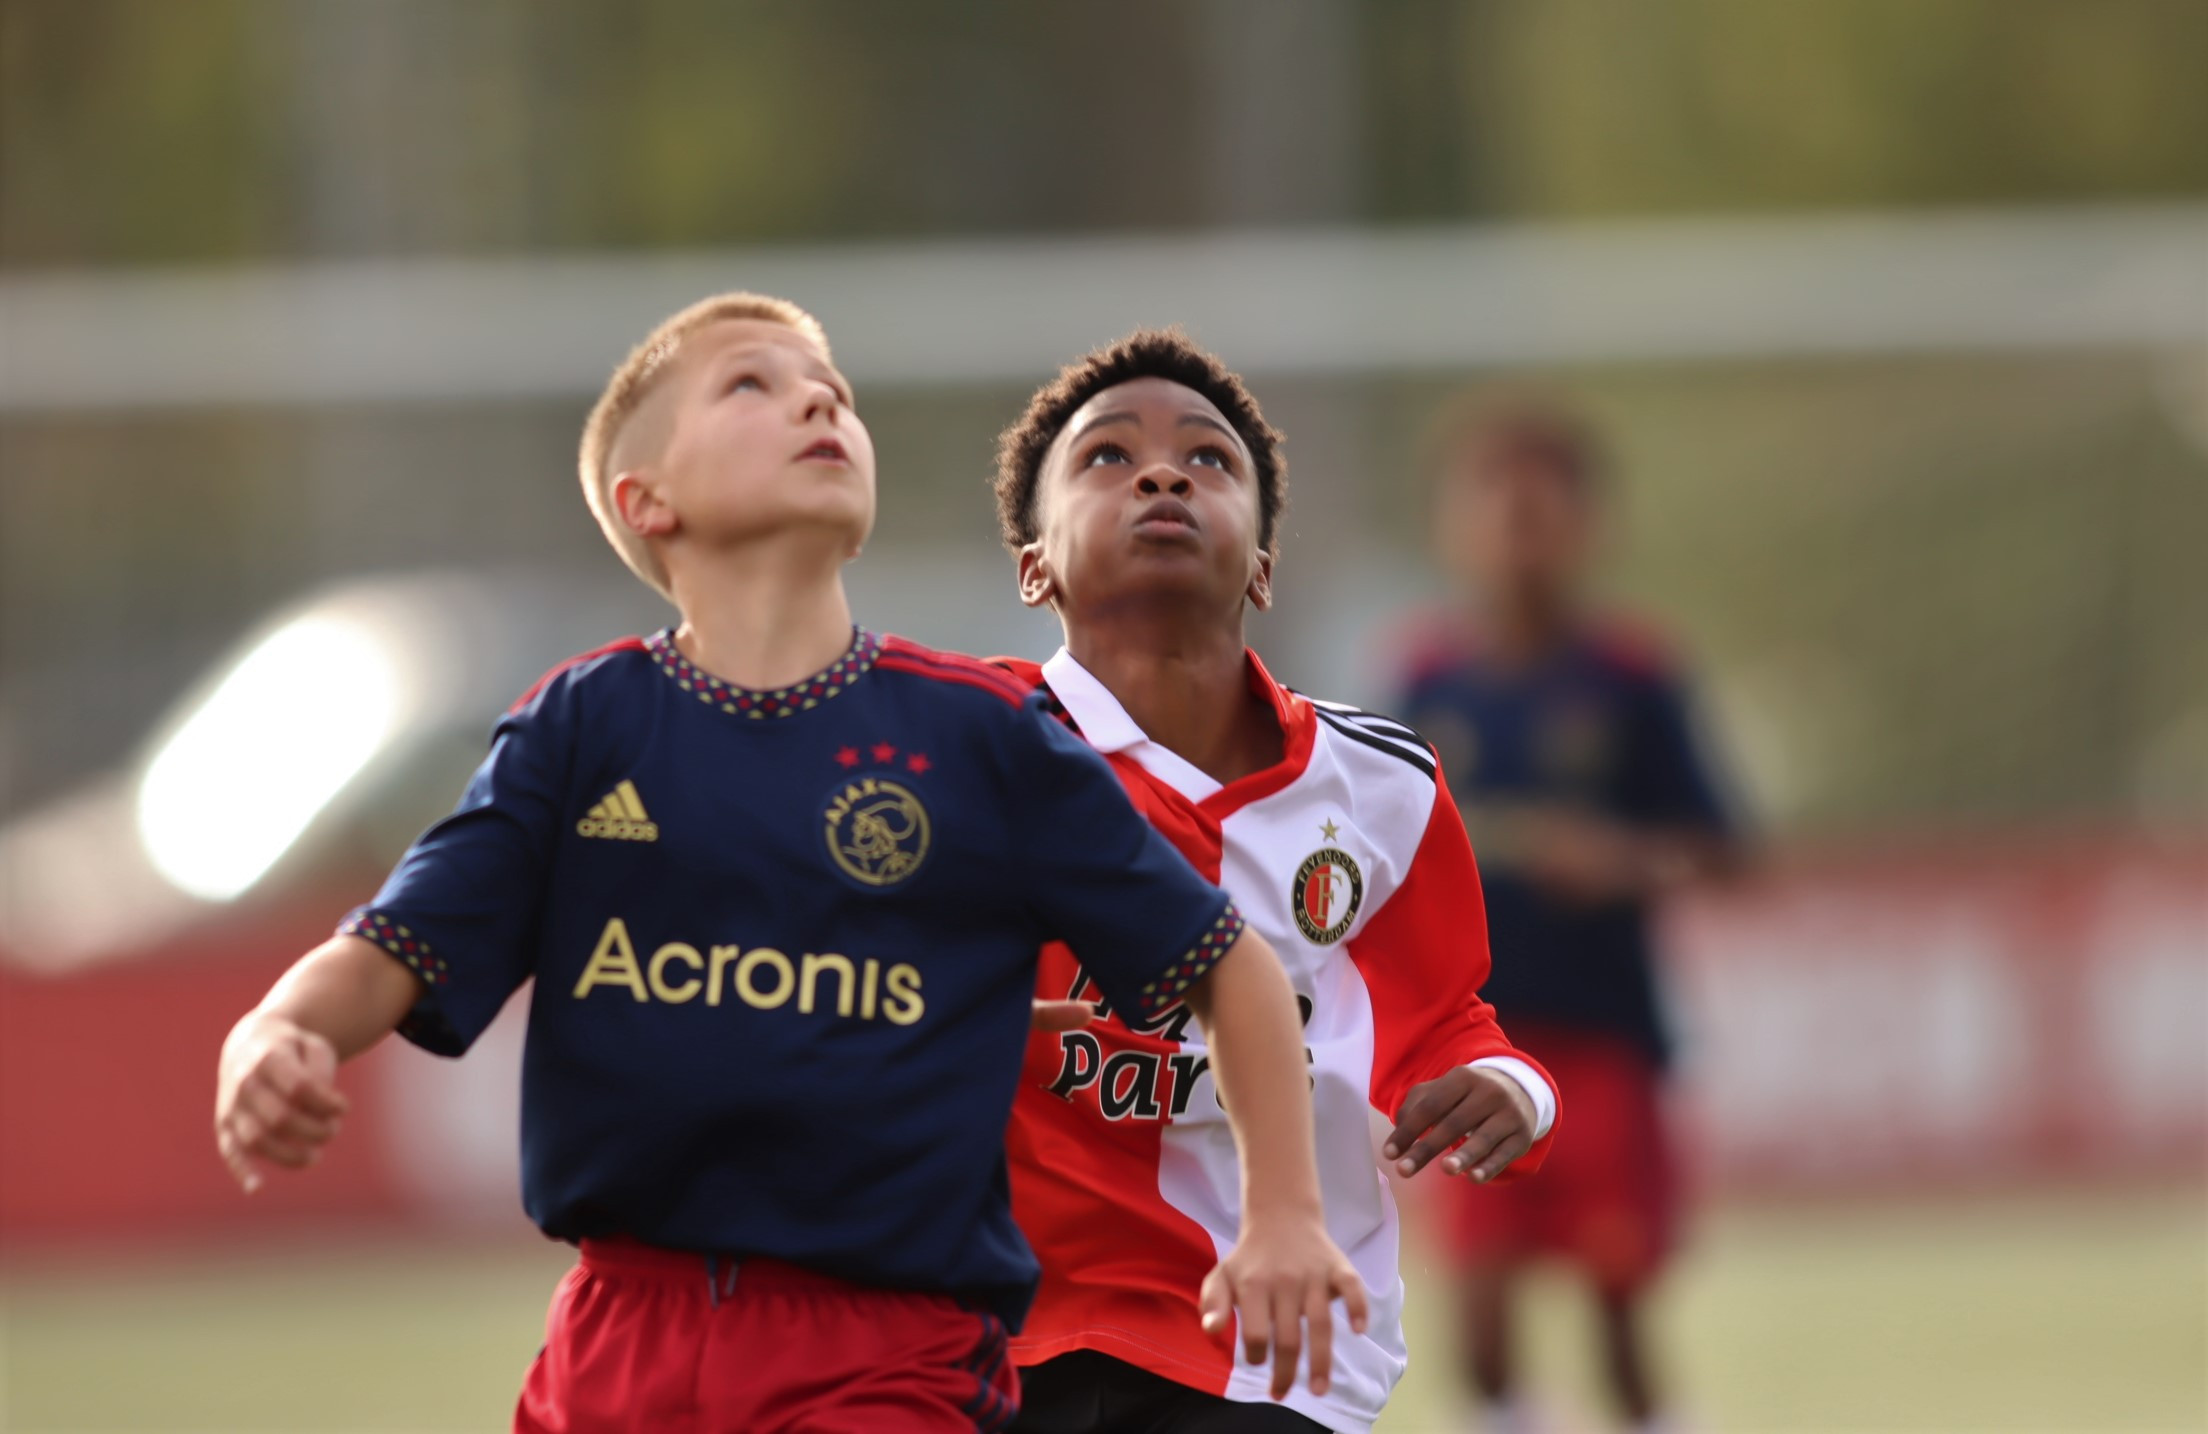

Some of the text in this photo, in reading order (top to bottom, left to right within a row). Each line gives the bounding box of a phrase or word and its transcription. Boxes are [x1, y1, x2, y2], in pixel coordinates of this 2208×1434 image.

[824, 778, 878, 825] AJAX
[576, 817, 659, 842] adidas
[1314, 872, 1342, 920] F
[572, 917, 925, 1026] Acronis
[1039, 1029, 1314, 1122] Par
